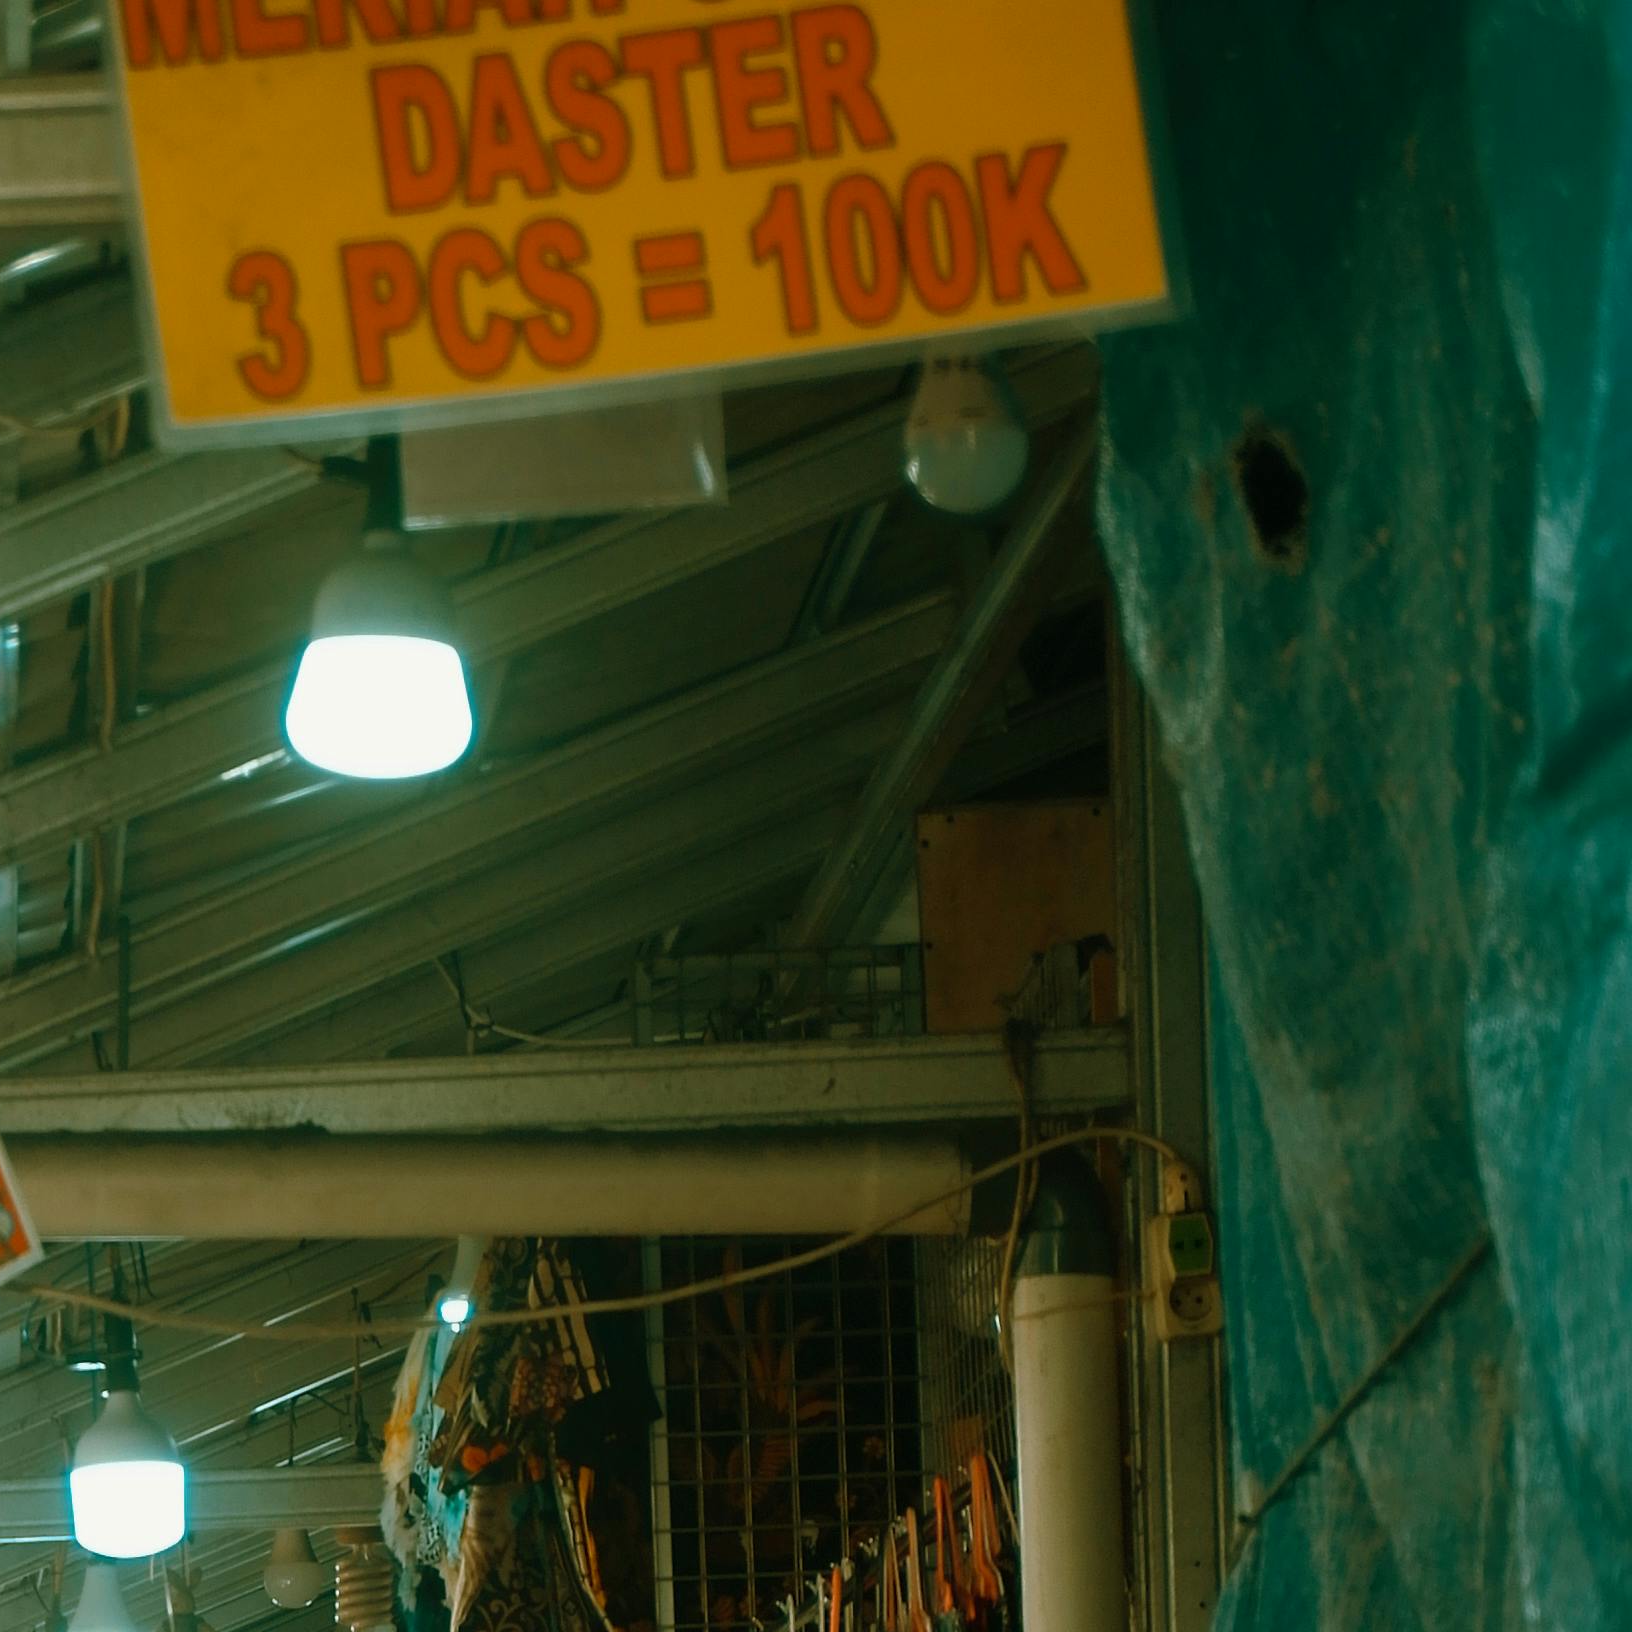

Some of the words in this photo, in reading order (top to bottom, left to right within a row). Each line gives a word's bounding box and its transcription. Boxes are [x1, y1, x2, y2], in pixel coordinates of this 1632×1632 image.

[369, 3, 895, 215] DASTER
[227, 250, 311, 400] 3
[339, 216, 603, 391] PCS
[751, 142, 1088, 337] 100K
